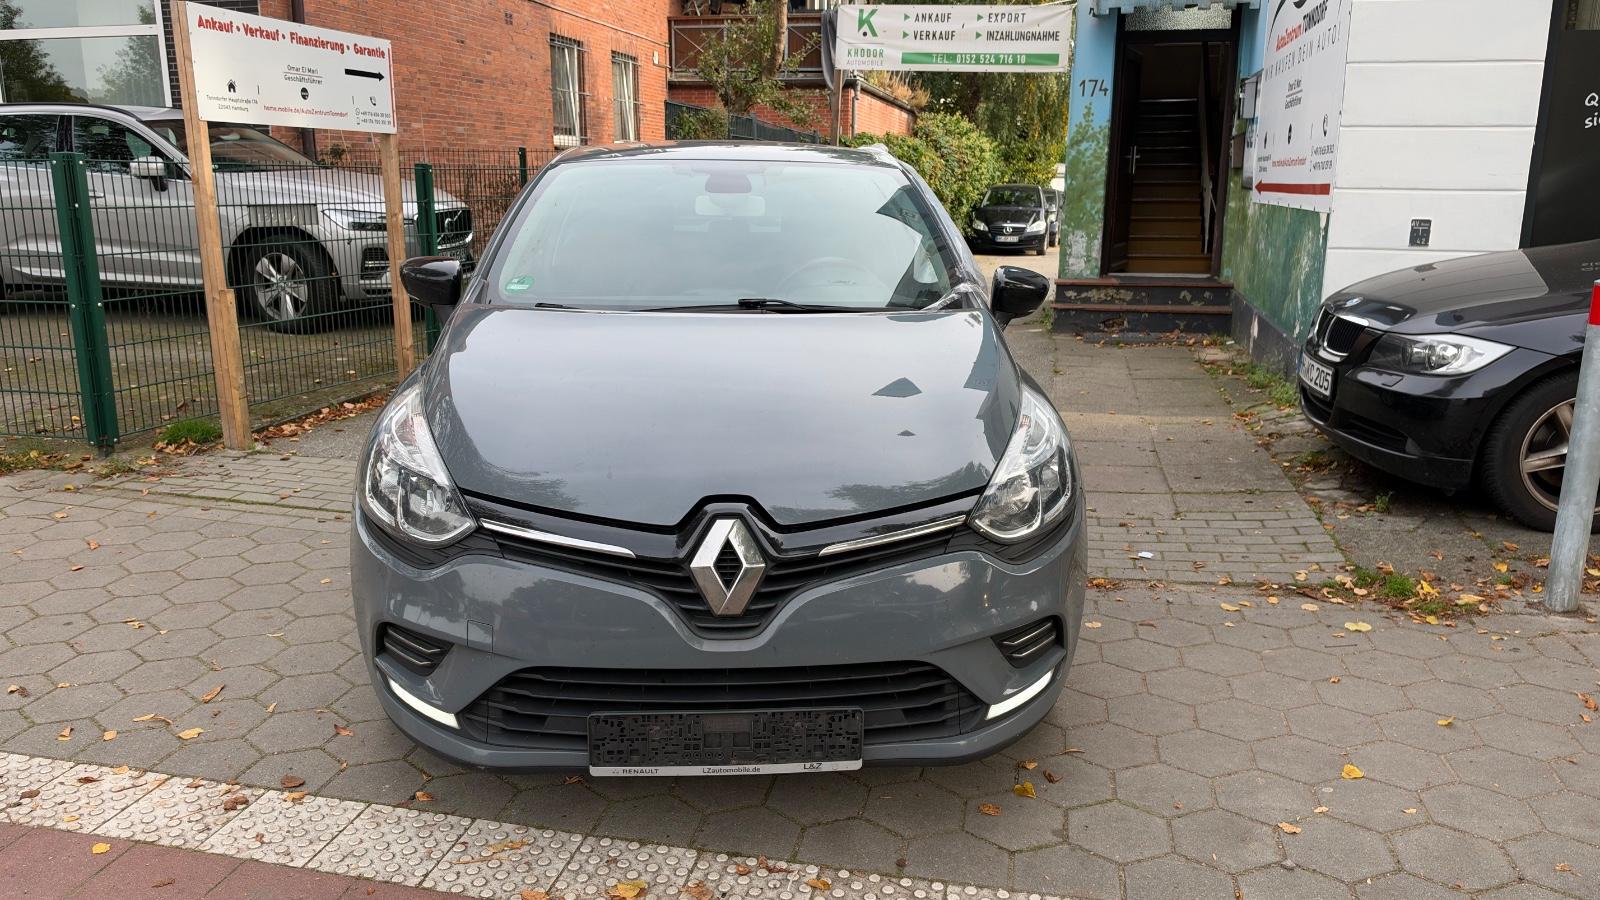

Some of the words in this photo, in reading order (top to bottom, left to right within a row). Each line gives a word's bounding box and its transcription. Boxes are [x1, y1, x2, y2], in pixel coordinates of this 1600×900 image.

[857, 8, 879, 38] K
[914, 12, 952, 23] ANKAUF
[987, 12, 1027, 23] EXPORT
[198, 14, 234, 34] Ankauf
[242, 23, 280, 42] Verkauf
[289, 31, 345, 55] Finanzierung
[353, 43, 386, 59] Garantie
[913, 30, 957, 41] VERKAUF
[986, 30, 1060, 41] INZAHLUNGNAHME
[847, 48, 884, 58] KHODOR
[1275, 51, 1296, 77] KAUFEN
[1298, 40, 1314, 65] DEIN
[846, 59, 884, 67] AUTOMOBILE
[932, 54, 953, 64] TEL:
[956, 54, 976, 64] 0152
[979, 54, 995, 64] 524
[999, 54, 1013, 64] 716
[1017, 54, 1026, 64] 10
[287, 64, 301, 73] Omar
[283, 74, 323, 85] Geschäftsführer
[1079, 79, 1109, 97] 174
[1584, 112, 1600, 129] si
[1314, 367, 1331, 391] 205
[702, 766, 761, 774] LZautomobile.de
[804, 762, 823, 770] L&Z
